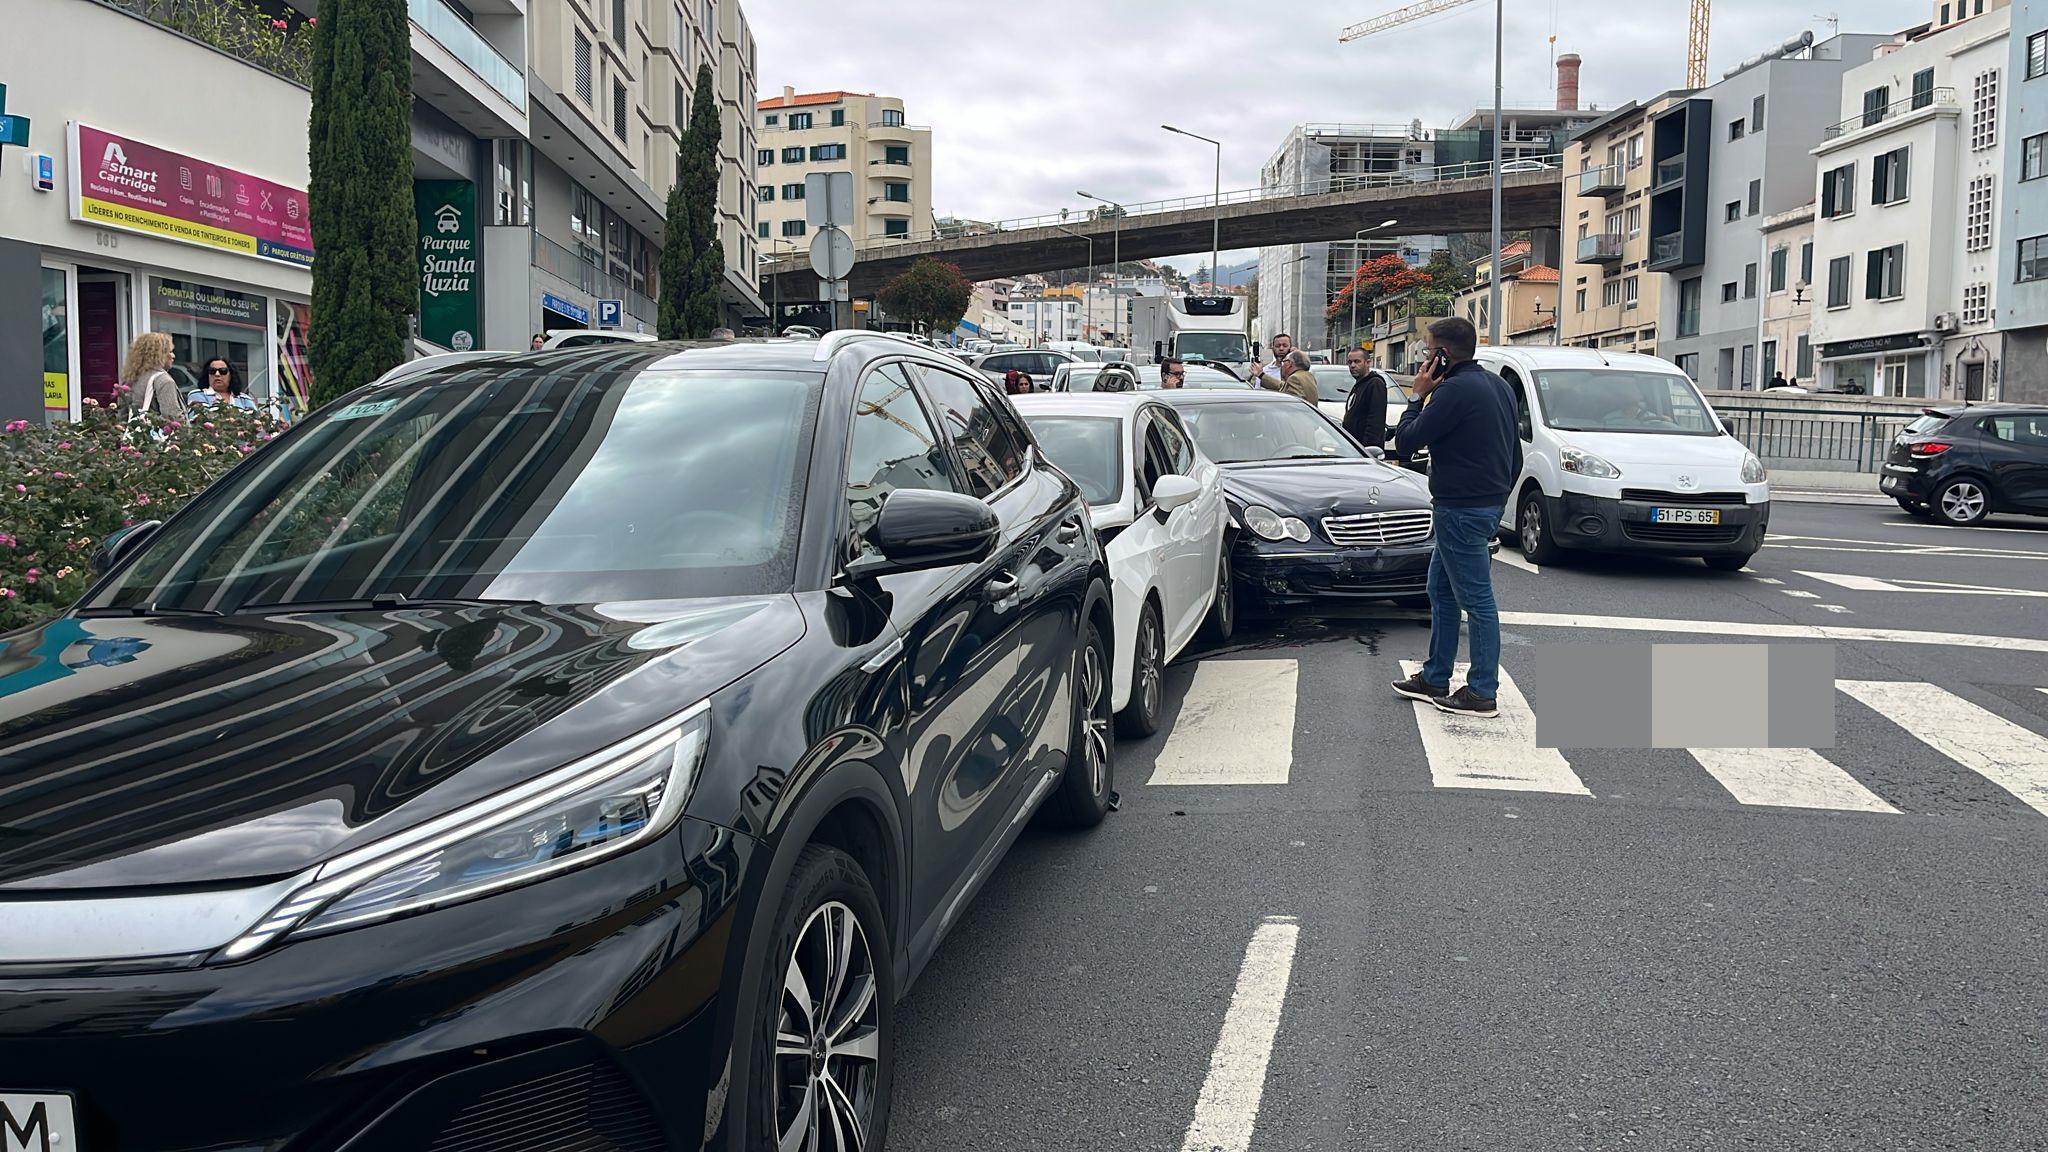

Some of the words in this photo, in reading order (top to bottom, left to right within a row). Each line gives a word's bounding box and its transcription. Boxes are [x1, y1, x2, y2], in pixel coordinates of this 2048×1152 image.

[99, 171, 156, 193] Cartridge
[109, 162, 158, 182] smart
[88, 204, 113, 217] LÍDERES
[114, 211, 124, 220] NO
[124, 213, 169, 230] REENCHIMENTO
[174, 225, 193, 236] VENDA
[193, 228, 201, 238] DE
[201, 231, 227, 244] TINTEIROS
[422, 235, 471, 254] Parque
[423, 254, 475, 273] Santa
[423, 273, 470, 297] Luzia
[157, 286, 195, 300] FORMATAR
[195, 292, 206, 302] OU
[207, 295, 231, 306] LIMPAR
[231, 298, 237, 307] O
[237, 299, 250, 310] SEU
[250, 302, 259, 311] PC
[602, 303, 617, 321] P
